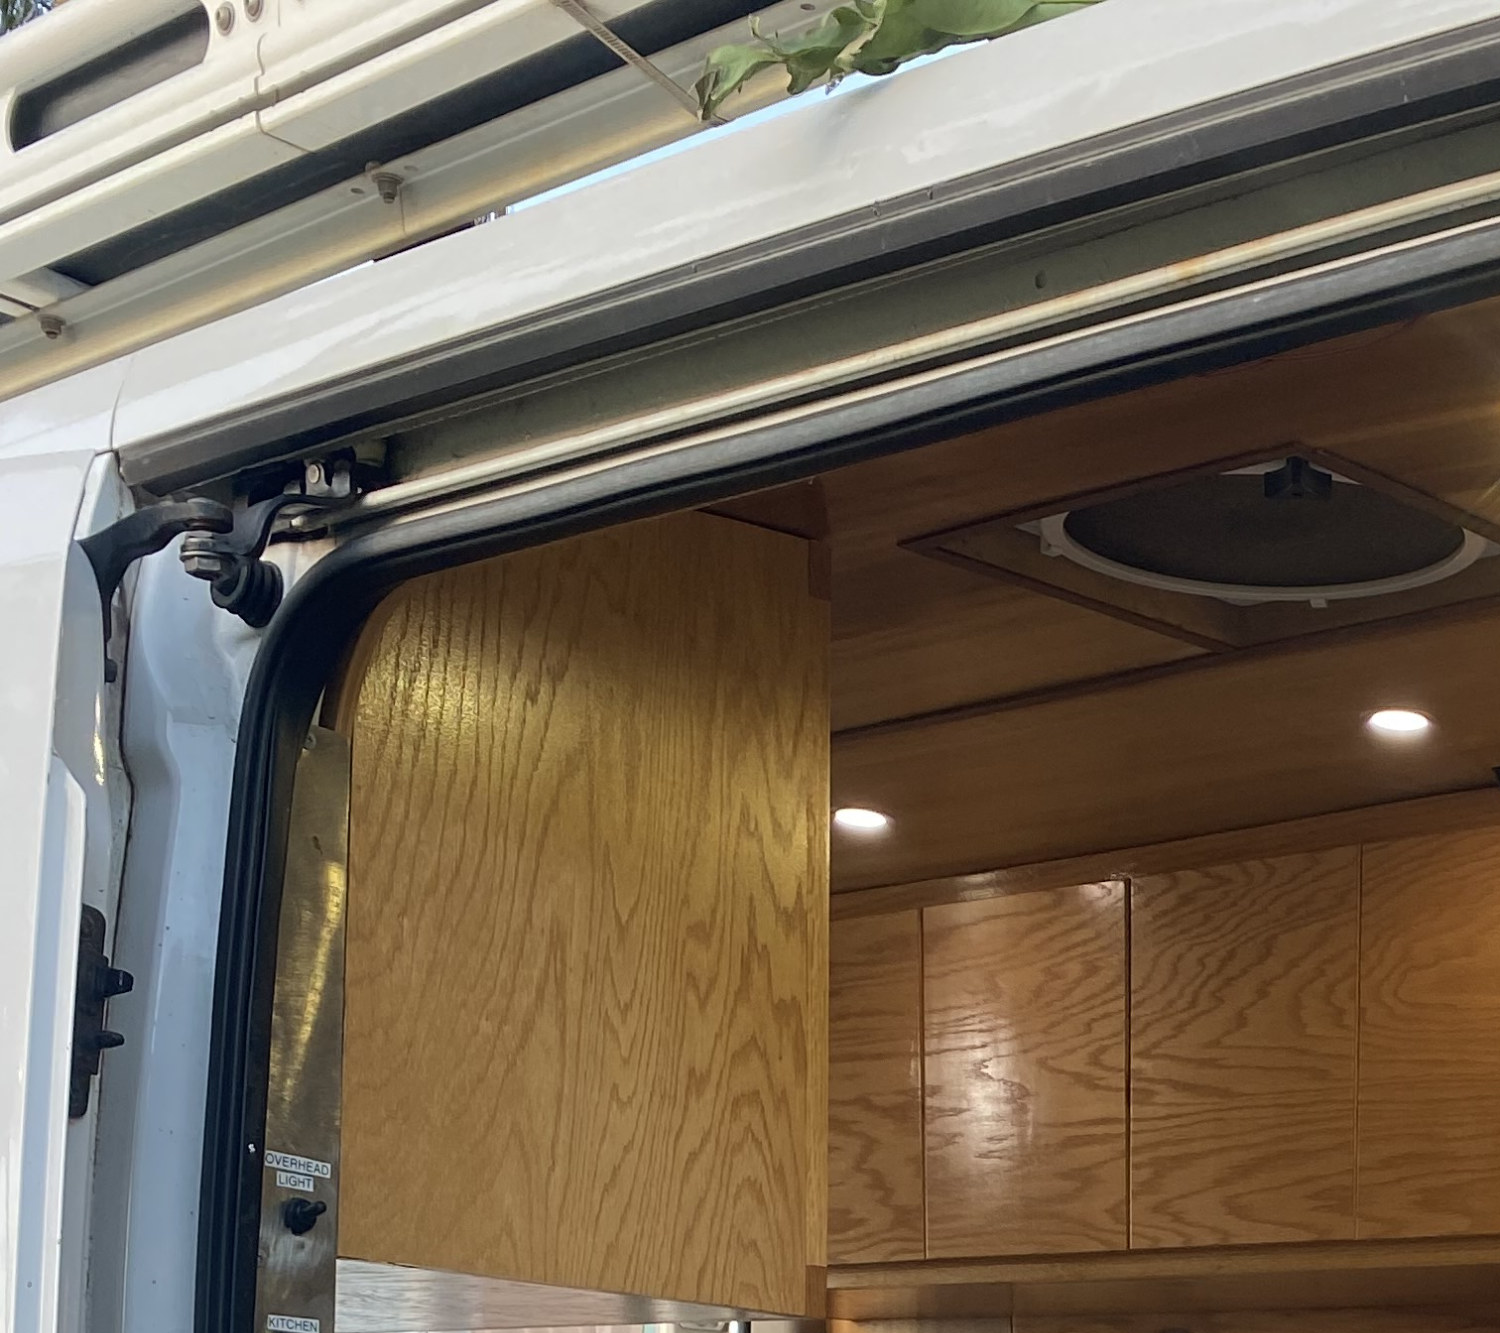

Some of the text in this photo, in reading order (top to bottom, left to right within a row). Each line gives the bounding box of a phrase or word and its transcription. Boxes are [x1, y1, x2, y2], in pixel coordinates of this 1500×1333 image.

[265, 1153, 329, 1176] OVERHEAD
[278, 1173, 313, 1190] LIGHT
[268, 1316, 318, 1332] KITCHEN
